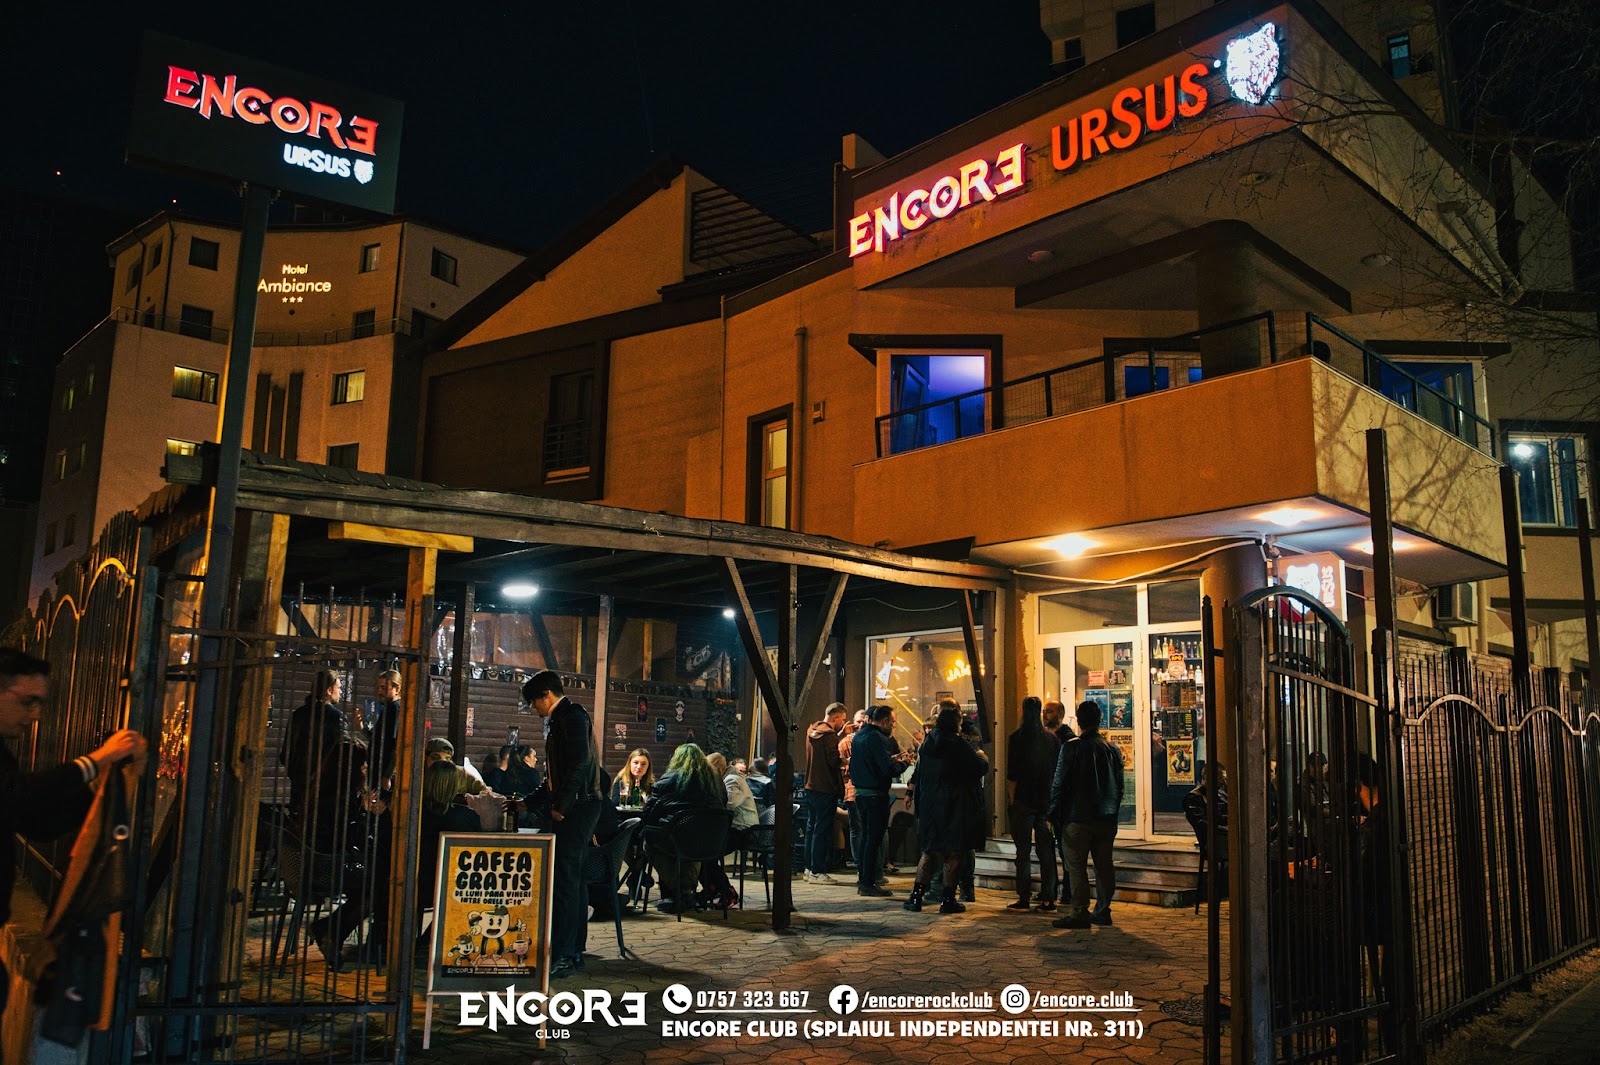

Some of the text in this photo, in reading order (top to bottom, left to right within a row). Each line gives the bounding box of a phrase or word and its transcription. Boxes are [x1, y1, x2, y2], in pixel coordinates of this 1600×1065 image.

[164, 65, 379, 156] ENCORE
[283, 143, 352, 178] URSUS
[848, 63, 1210, 258] ENCORE URSUS
[282, 263, 309, 275] Hotel
[257, 277, 332, 293] Ambiance
[458, 850, 532, 872] CAFEA
[456, 871, 532, 891] GRATIS
[465, 890, 483, 898] LUNI
[506, 890, 531, 898] VINERI
